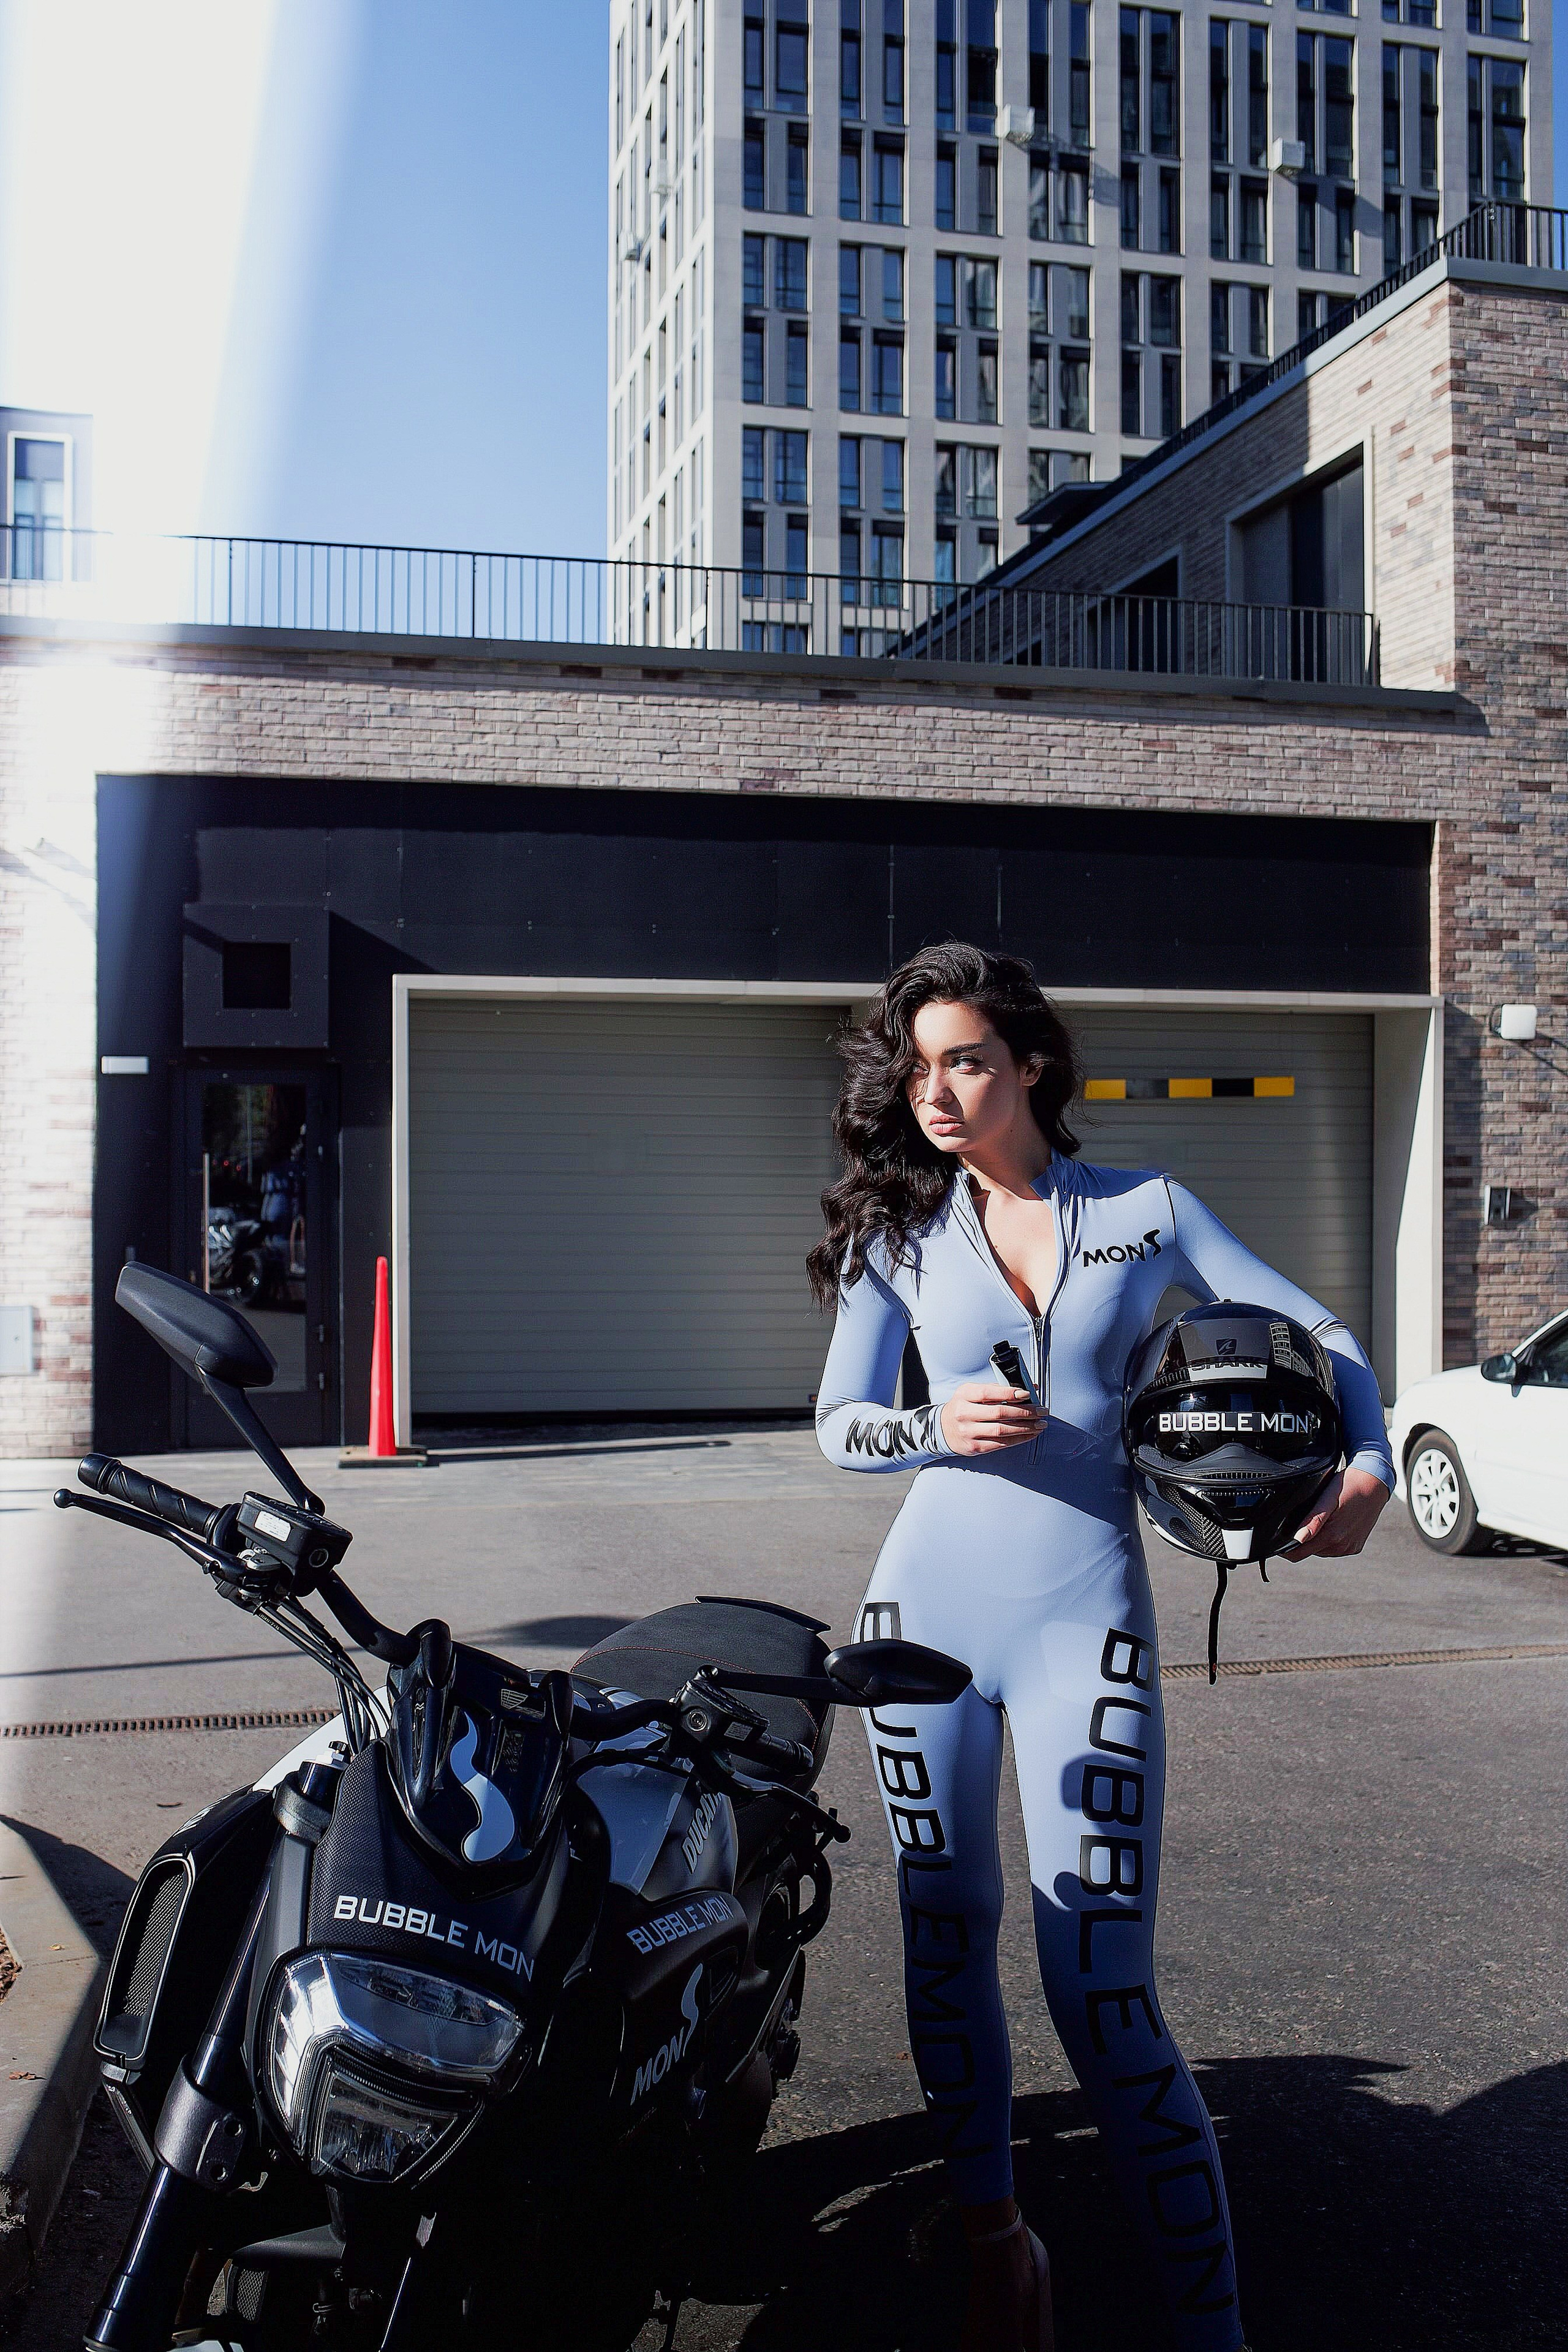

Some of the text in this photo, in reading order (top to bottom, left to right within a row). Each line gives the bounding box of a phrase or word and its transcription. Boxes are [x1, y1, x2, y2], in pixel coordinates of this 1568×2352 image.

[1159, 1412, 1309, 1433] BUBBLE MON
[333, 1894, 535, 1982] BUBBLE MON
